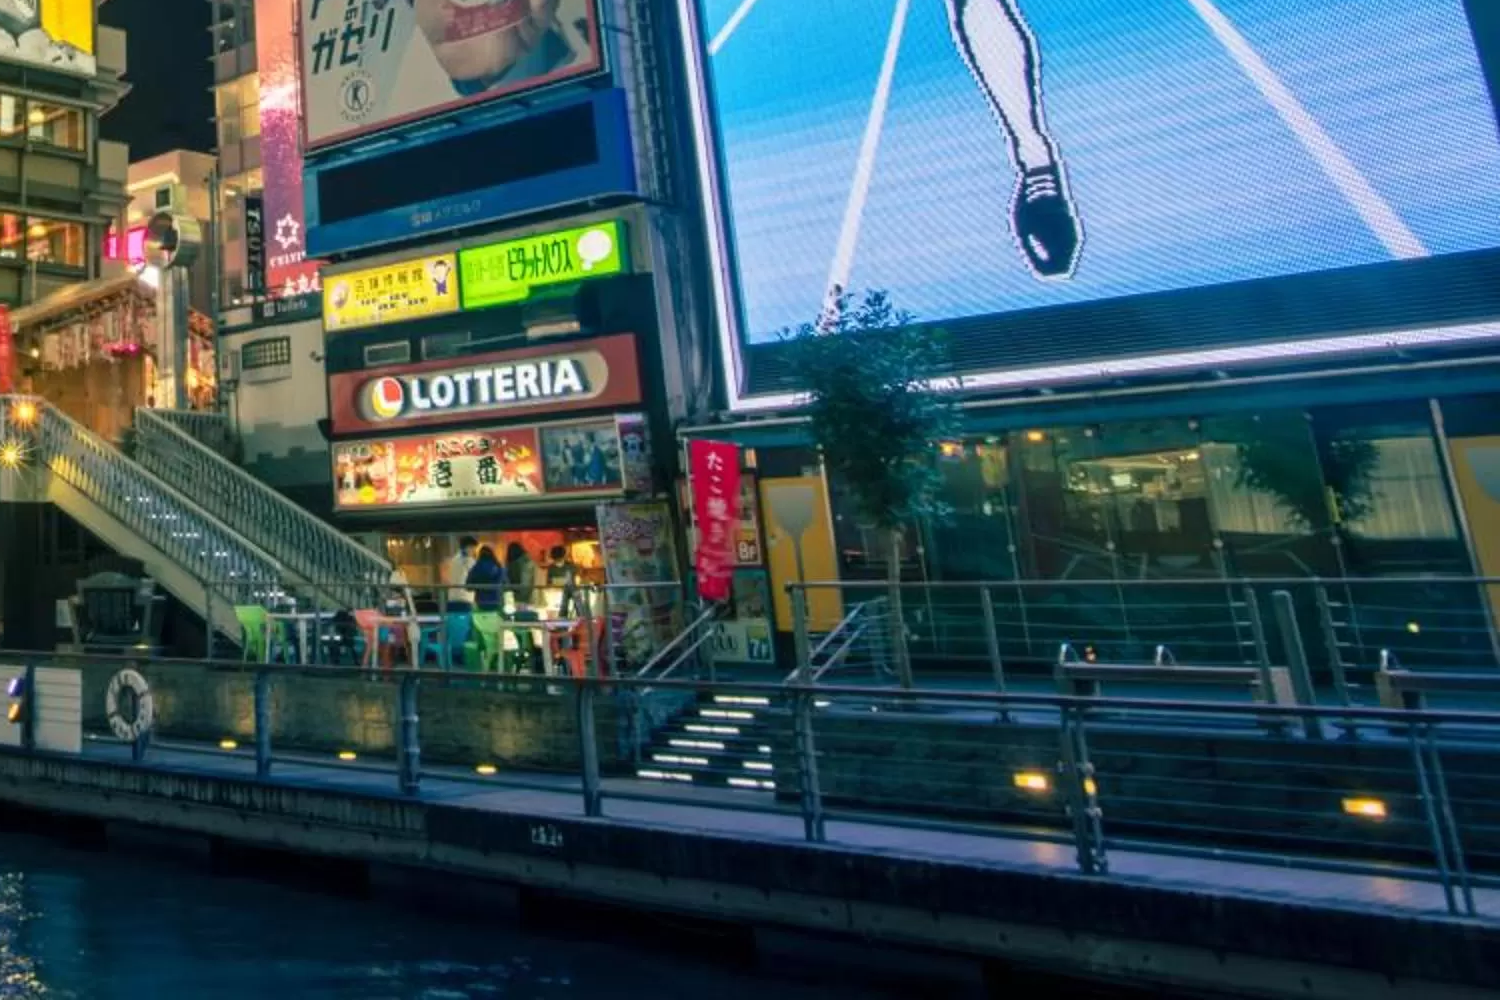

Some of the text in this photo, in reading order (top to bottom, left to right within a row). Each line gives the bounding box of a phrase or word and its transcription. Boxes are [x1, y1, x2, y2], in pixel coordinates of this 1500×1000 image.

[311, 7, 396, 75] ガセリ
[411, 358, 584, 410] LOTTERIA
